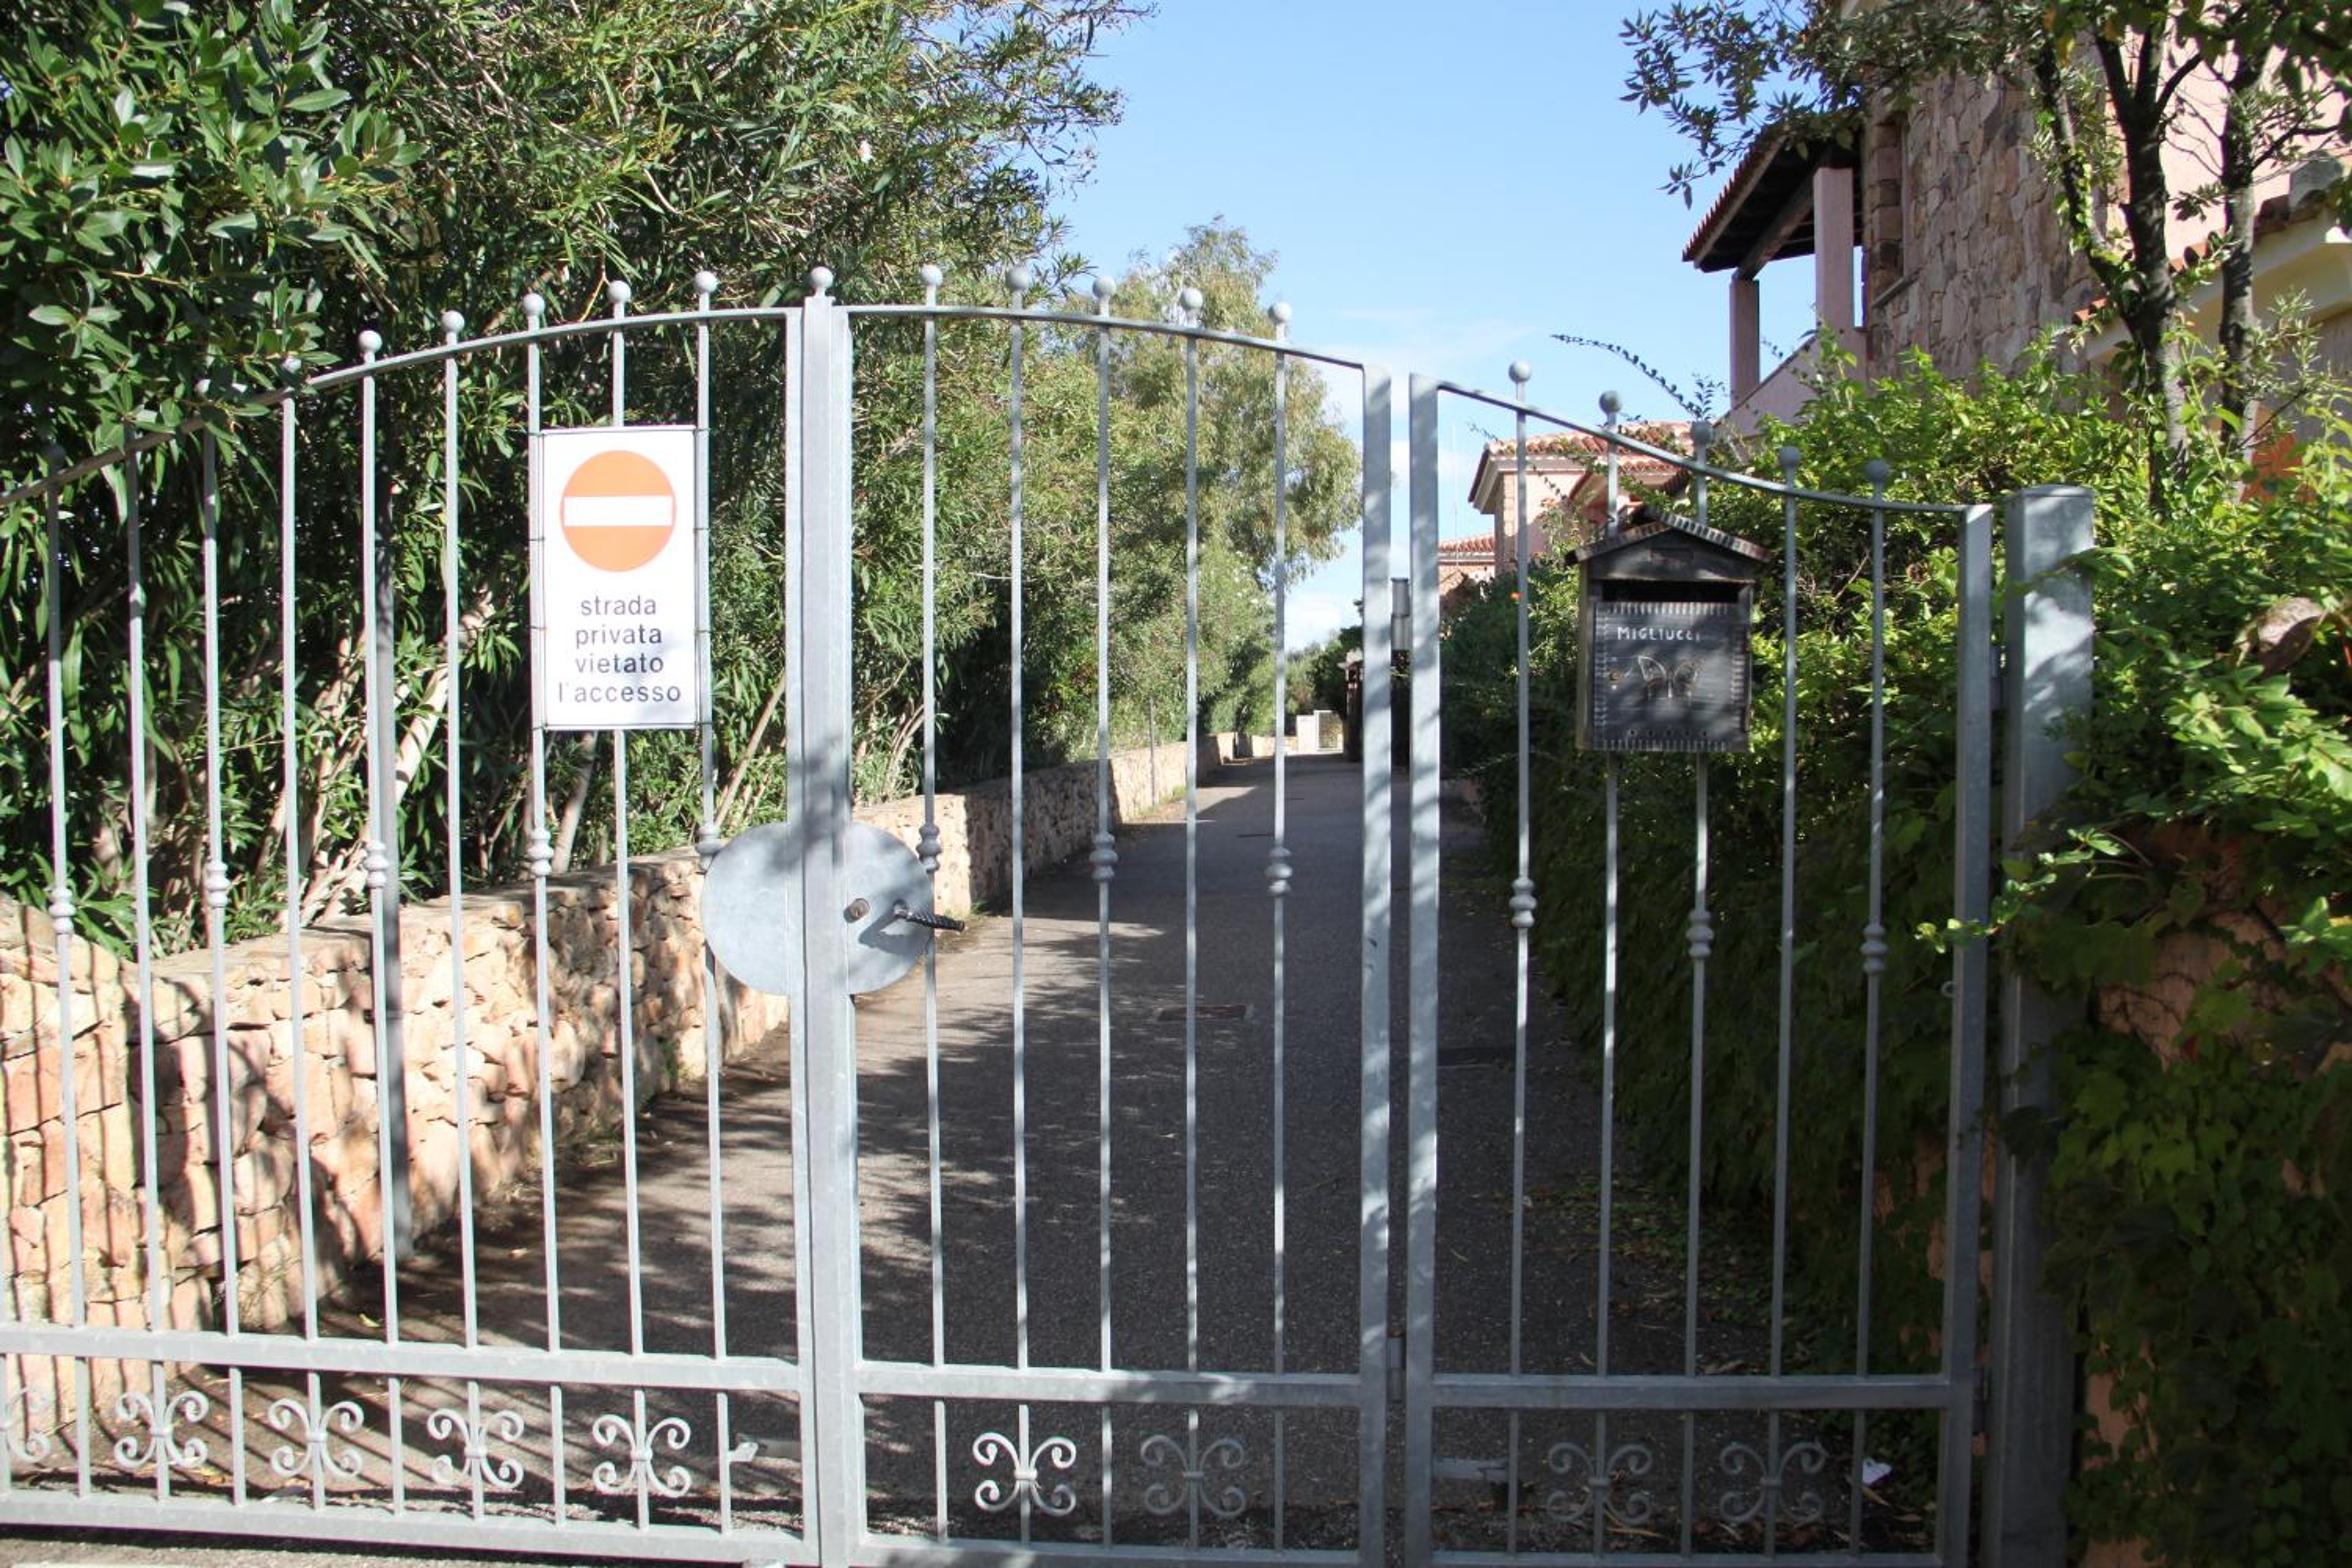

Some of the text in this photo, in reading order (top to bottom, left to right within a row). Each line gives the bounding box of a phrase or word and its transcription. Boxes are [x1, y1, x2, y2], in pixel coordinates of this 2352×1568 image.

[580, 595, 657, 616] strada
[576, 624, 662, 649] privata
[575, 653, 664, 674] vietato
[558, 682, 682, 703] l'accesso
